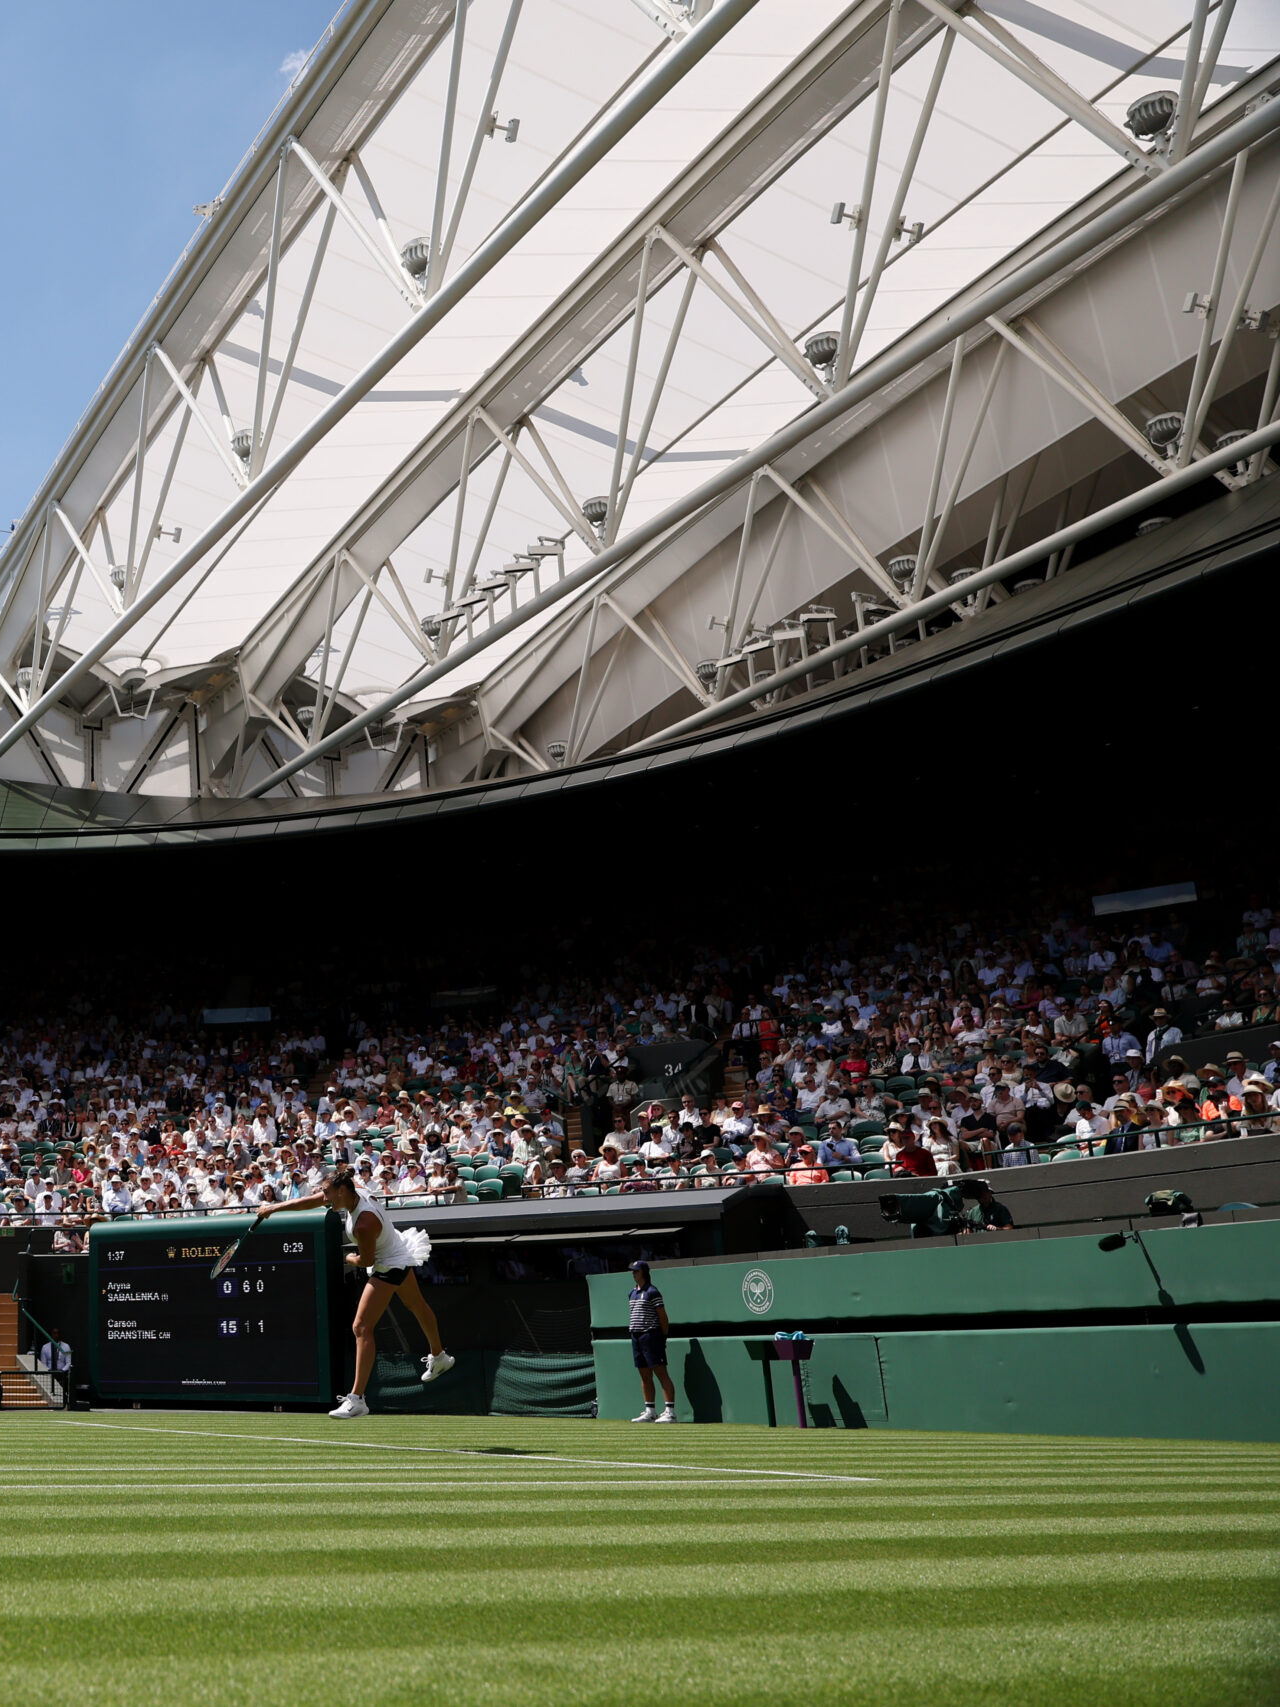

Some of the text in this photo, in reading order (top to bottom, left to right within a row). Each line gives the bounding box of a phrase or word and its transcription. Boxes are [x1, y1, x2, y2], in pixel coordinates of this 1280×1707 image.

[664, 1062, 682, 1076] 34
[181, 1246, 221, 1258] ROLEX
[282, 1242, 304, 1253] 0:29
[107, 1250, 125, 1261] 1:37
[107, 1282, 131, 1292] Aryna
[223, 1280, 264, 1293] 0 6 0
[107, 1292, 160, 1302] SABALENKA
[107, 1319, 137, 1328] Carson
[220, 1320, 264, 1333] 15 1 1
[107, 1330, 157, 1340] BRANSTINE
